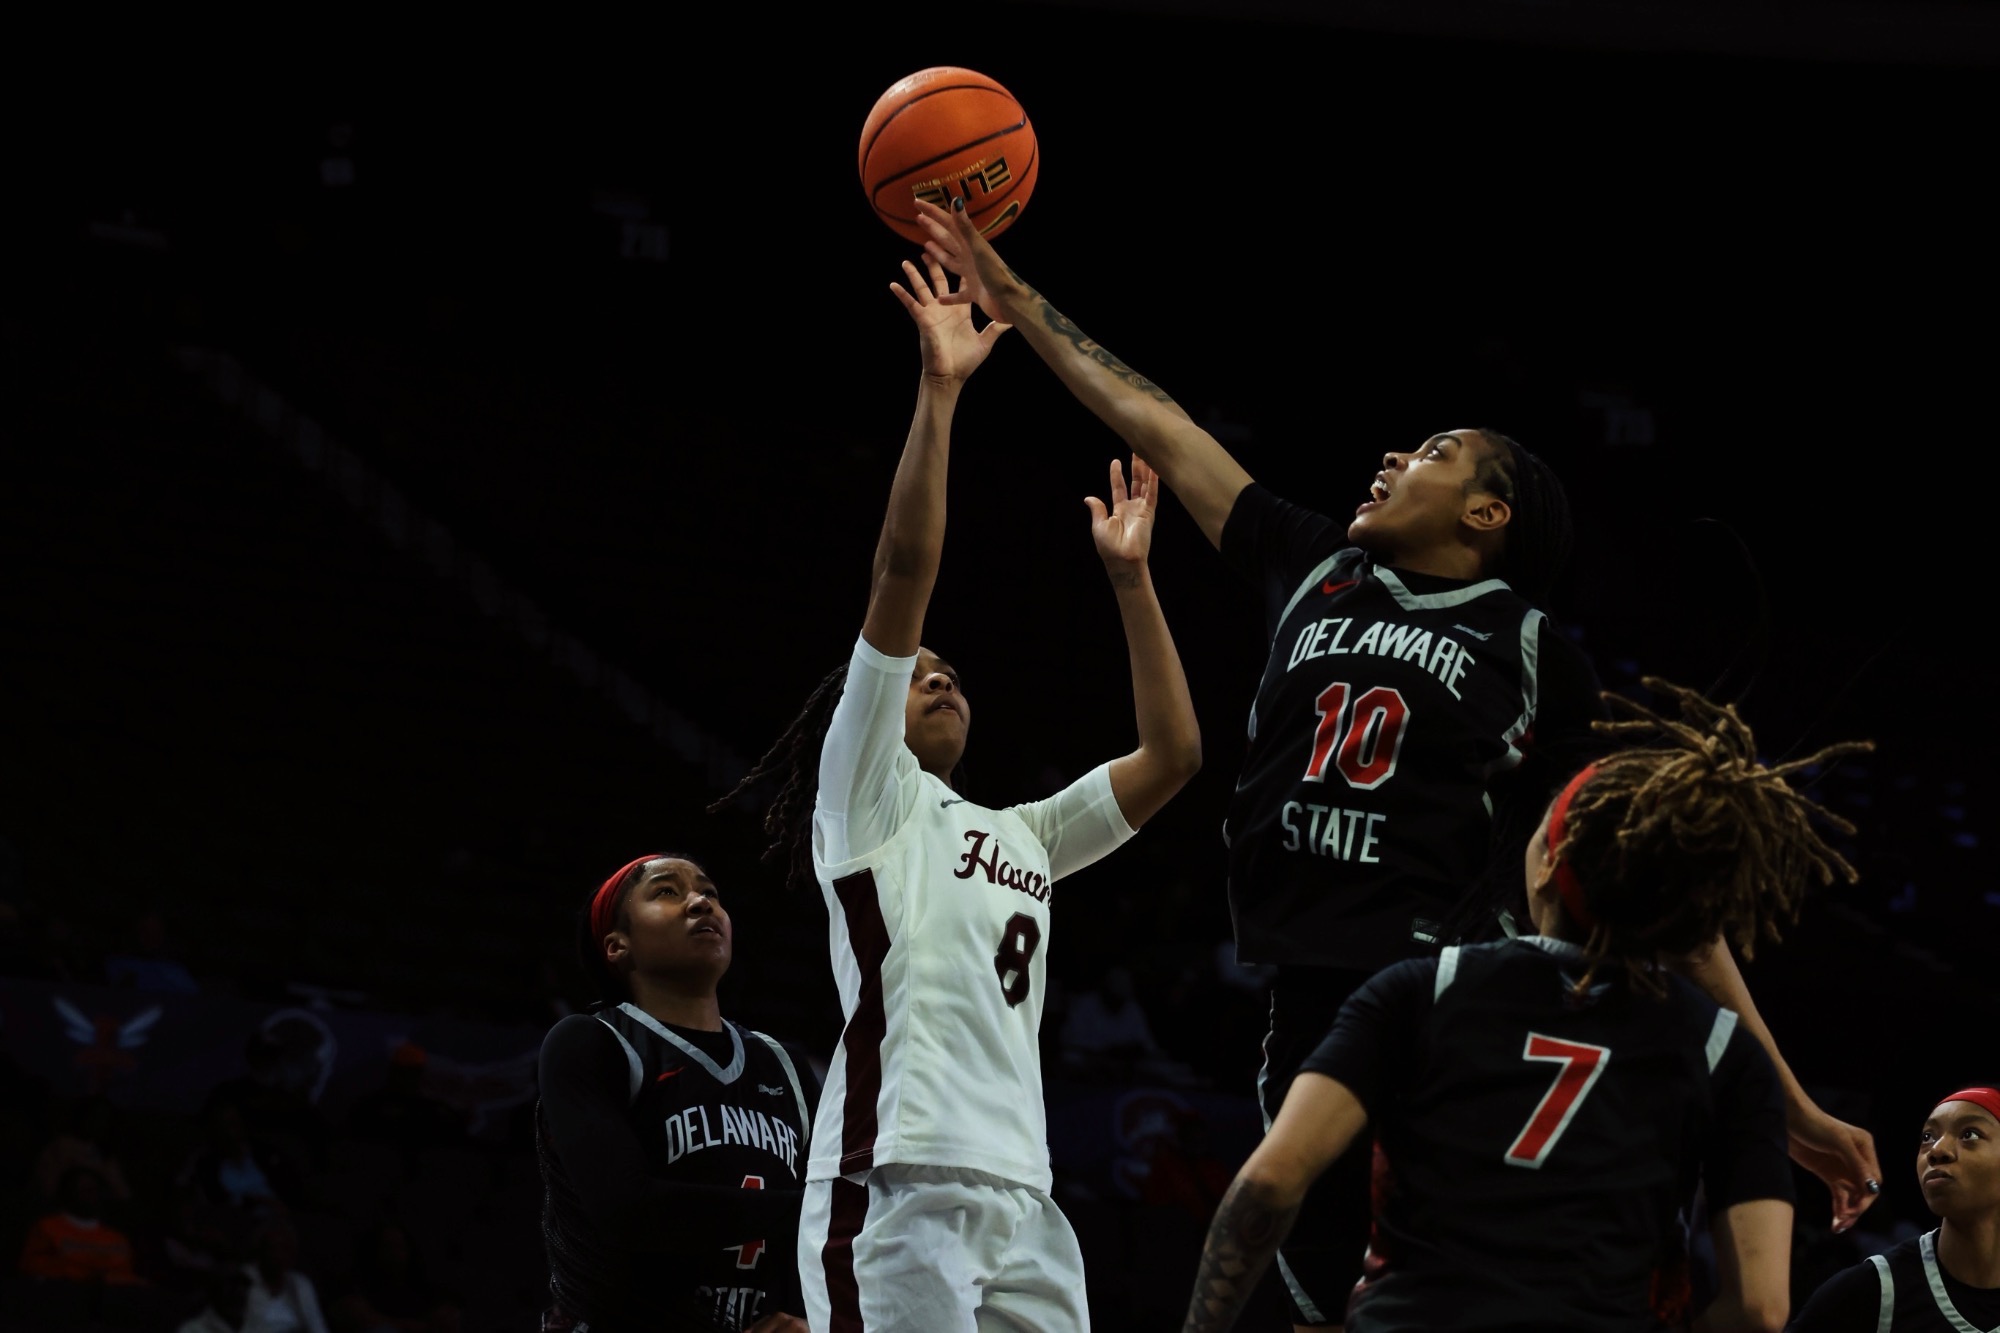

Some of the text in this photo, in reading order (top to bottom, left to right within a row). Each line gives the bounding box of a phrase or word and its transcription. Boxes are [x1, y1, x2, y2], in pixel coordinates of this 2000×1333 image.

[1287, 617, 1476, 702] DELAWARE
[1302, 681, 1411, 791] 10
[1281, 800, 1387, 864] STATE
[994, 911, 1041, 1009] 8
[665, 1104, 798, 1180] DELAWARE
[1503, 1031, 1612, 1170] 7
